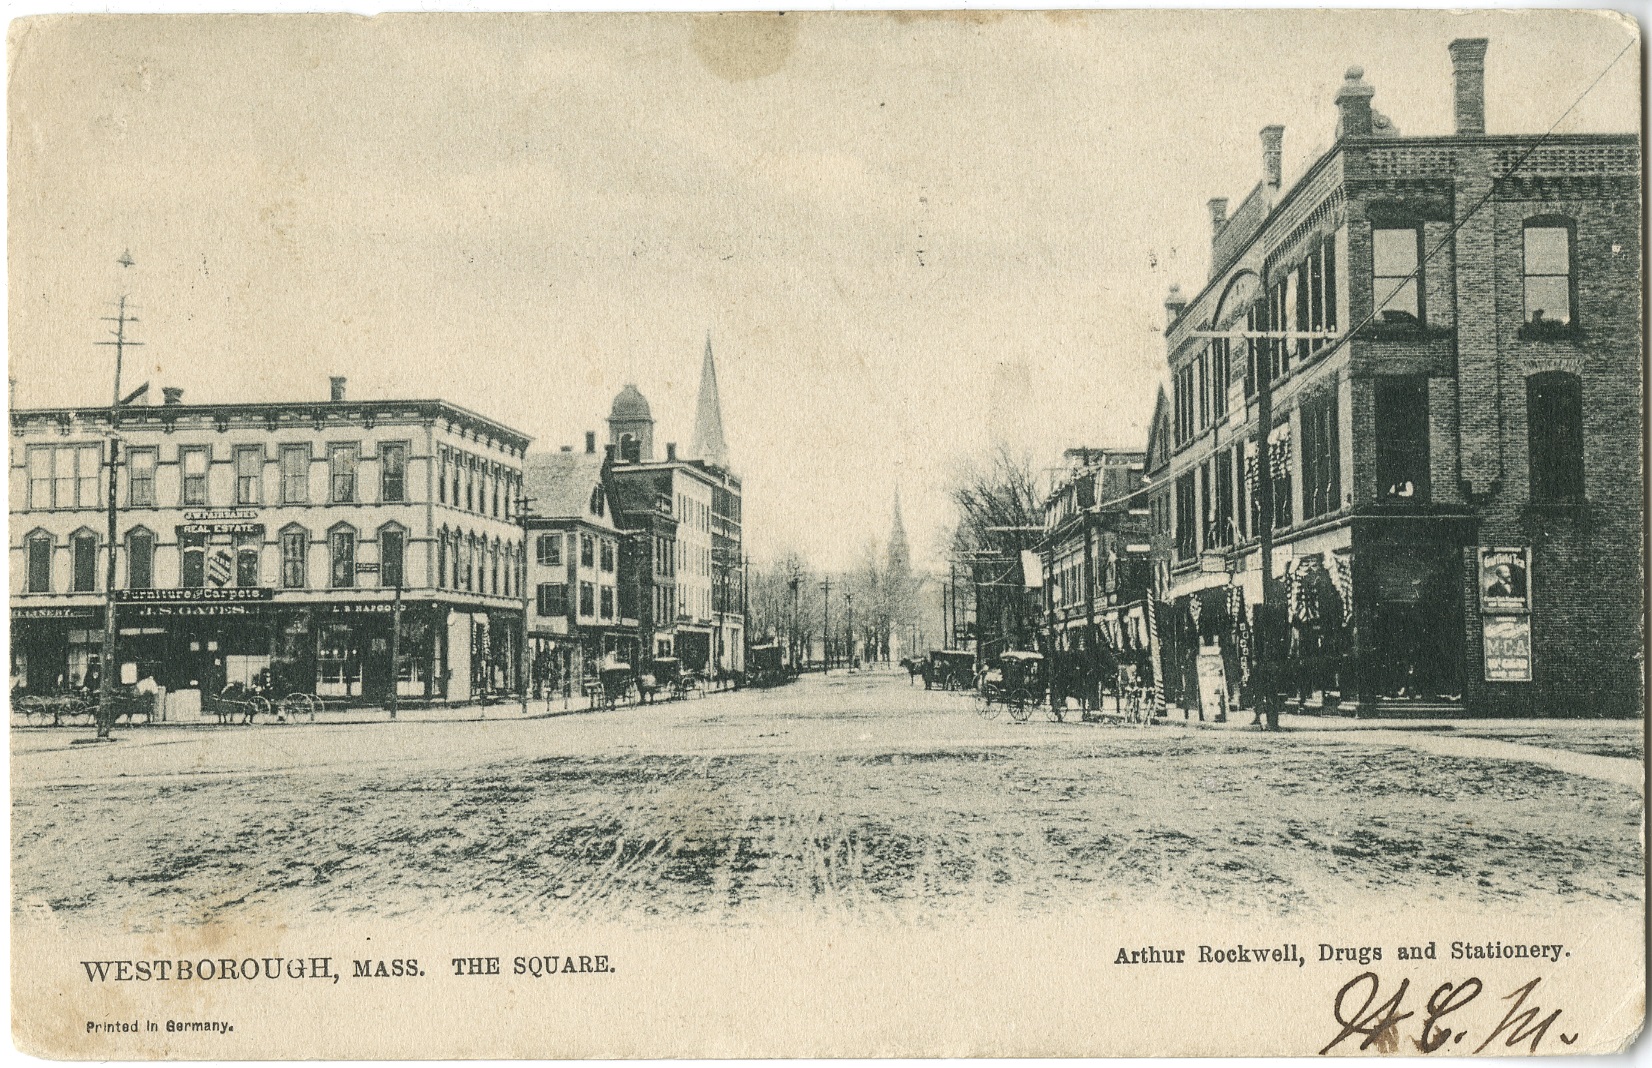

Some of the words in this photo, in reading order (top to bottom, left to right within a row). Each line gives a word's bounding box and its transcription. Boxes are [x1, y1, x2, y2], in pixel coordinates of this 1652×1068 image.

[183, 525, 211, 534] REAL
[122, 589, 192, 600] Furniture
[204, 588, 264, 600] Carpets.
